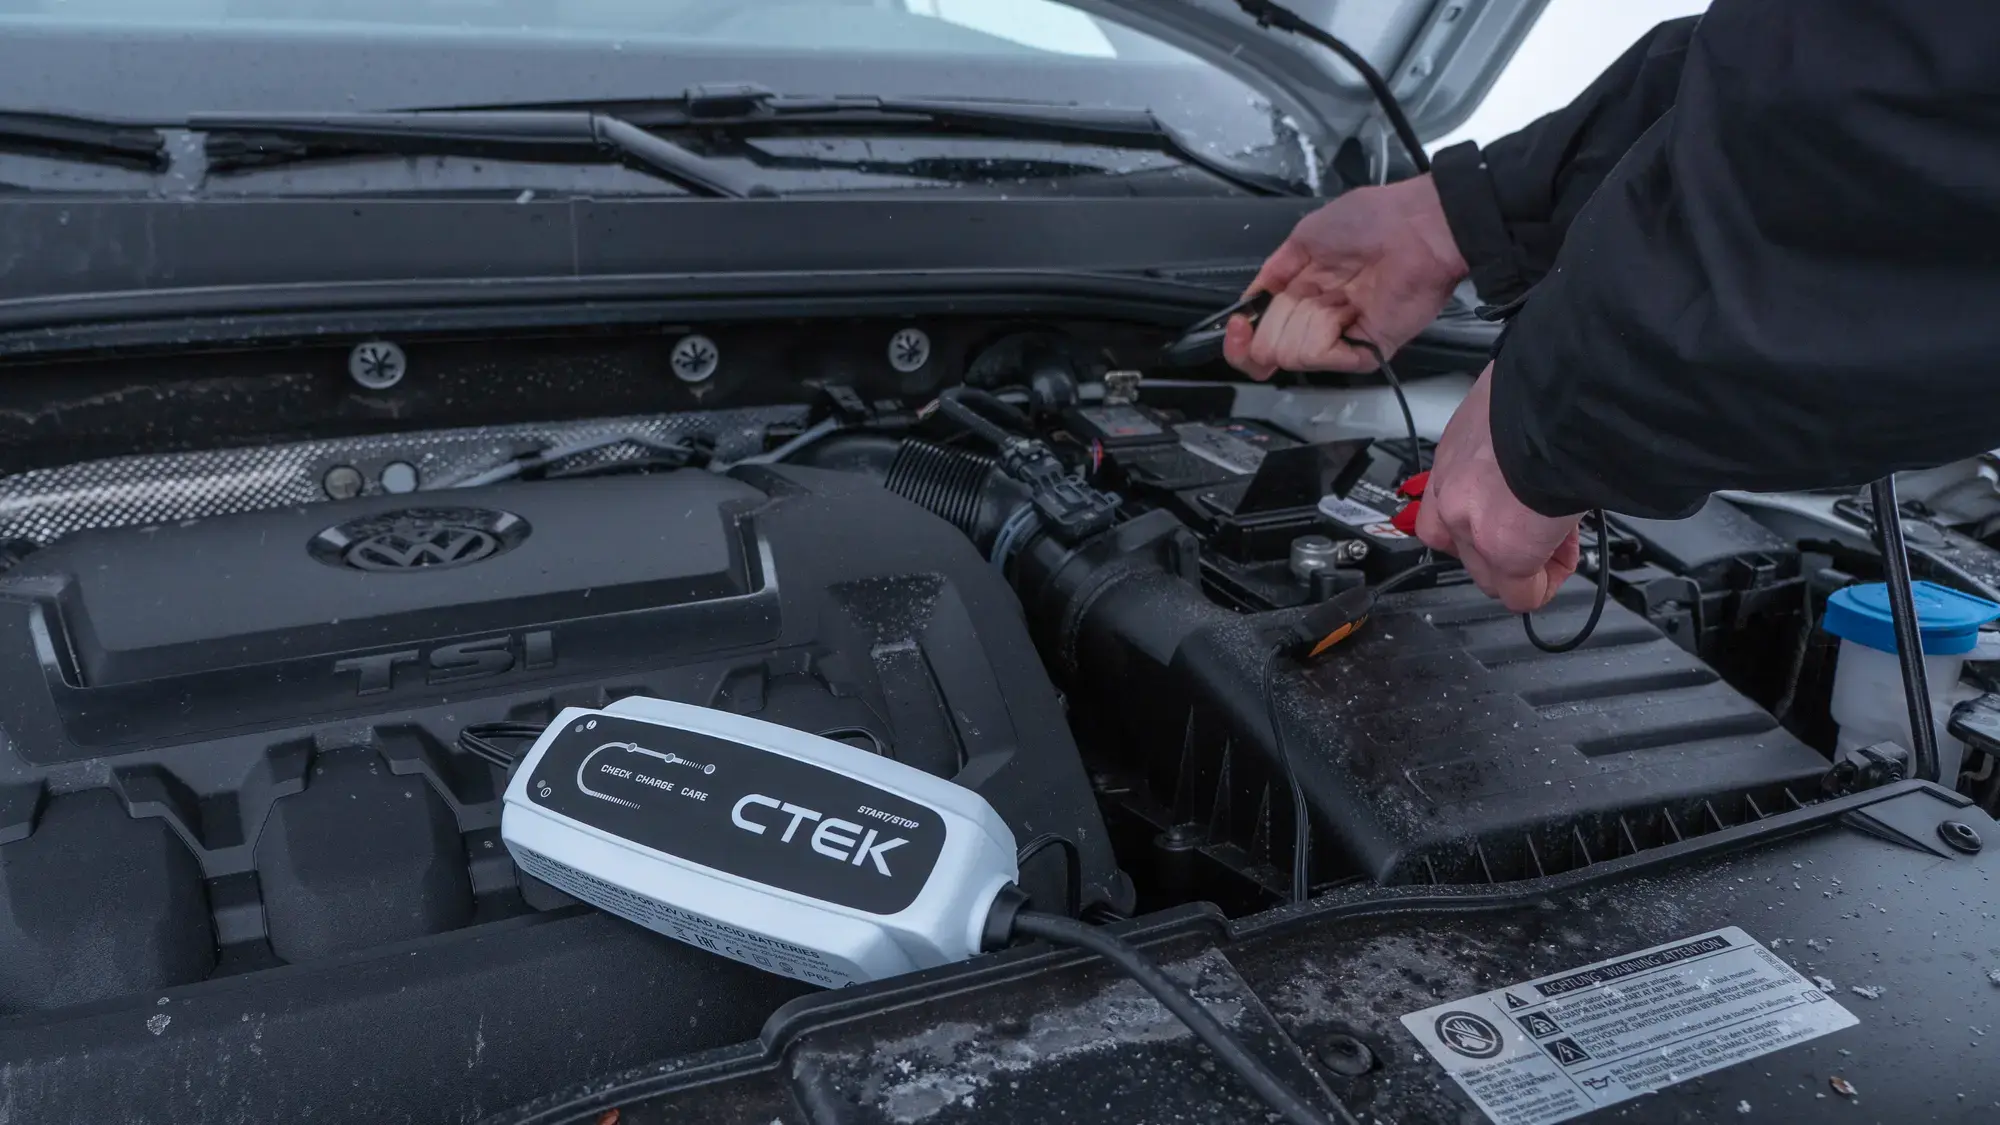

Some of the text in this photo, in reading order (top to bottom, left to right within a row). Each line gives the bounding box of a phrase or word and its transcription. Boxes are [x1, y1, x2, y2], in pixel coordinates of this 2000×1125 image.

[333, 629, 557, 697] TSI
[600, 764, 709, 802] CHECK CHARGE CARE
[731, 793, 910, 878] CTEK
[857, 805, 919, 830] START/STOP
[527, 849, 820, 959] BATTERY CHARGER FOR 12V LEAD ACID BATTERIES
[803, 970, 832, 983] IP65
[1540, 938, 1722, 994] ACHTUNG WARNING ATTENTION
[1552, 1006, 1591, 1021] RADIATOR
[1619, 991, 1643, 1002] START
[1577, 1034, 1600, 1045] HIGH
[1630, 1016, 1662, 1029] SWITCH
[1697, 997, 1727, 1009] BEFORE
[1723, 987, 1762, 1001] TOUCHING
